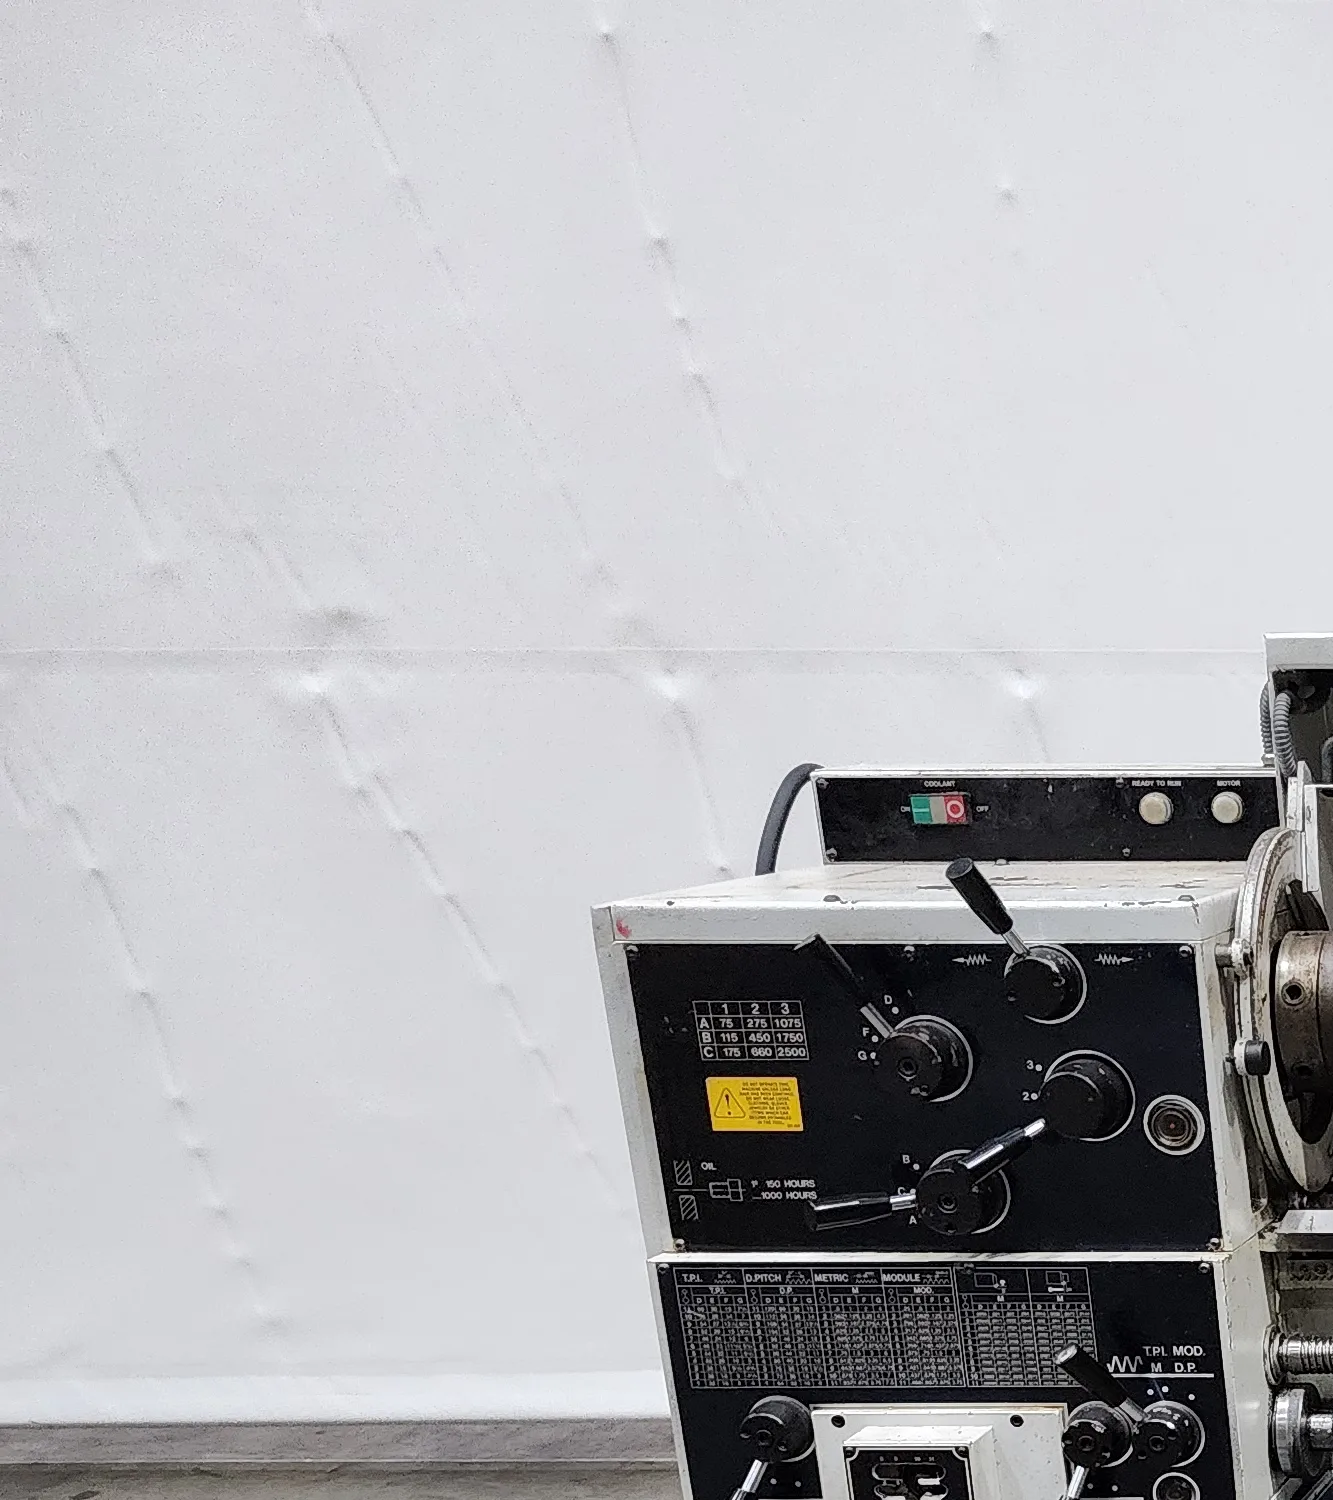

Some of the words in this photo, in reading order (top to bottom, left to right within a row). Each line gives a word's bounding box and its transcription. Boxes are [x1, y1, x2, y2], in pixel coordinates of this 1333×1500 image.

[923, 780, 956, 788] COOLANT
[975, 805, 989, 813] OFF
[884, 995, 893, 1004] D
[721, 1003, 729, 1014] 1
[751, 1003, 761, 1014] 2
[780, 1003, 790, 1014] 3
[699, 1018, 710, 1028] A
[719, 1018, 734, 1028] 75
[746, 1018, 768, 1028] 275
[774, 1018, 802, 1028] 1075
[862, 1027, 870, 1037] F
[701, 1032, 712, 1043] B
[719, 1032, 739, 1043] 115
[748, 1032, 771, 1043] 450
[776, 1032, 804, 1043] 1750
[703, 1047, 714, 1058] C
[722, 1047, 741, 1057] 175
[750, 1047, 773, 1057] 660
[777, 1047, 806, 1057] 2500
[857, 1051, 868, 1060] G
[1026, 1059, 1034, 1070] 3
[1022, 1091, 1030, 1101] 2
[902, 1154, 911, 1164] B
[700, 1162, 718, 1171] OIL
[765, 1180, 781, 1188] 150
[783, 1179, 816, 1188] HOURS
[760, 1191, 783, 1200] 1000
[785, 1191, 818, 1200] HOURS
[908, 1215, 918, 1225] A
[681, 1273, 704, 1283] T.P.I.
[745, 1273, 782, 1283] D.PITCH
[814, 1273, 849, 1283] METRIC
[881, 1273, 921, 1282] MODULE
[1142, 1345, 1168, 1357] T.P.I.
[1172, 1345, 1207, 1357] MOD.
[1150, 1362, 1163, 1373] M
[1174, 1362, 1198, 1373] D.P.
